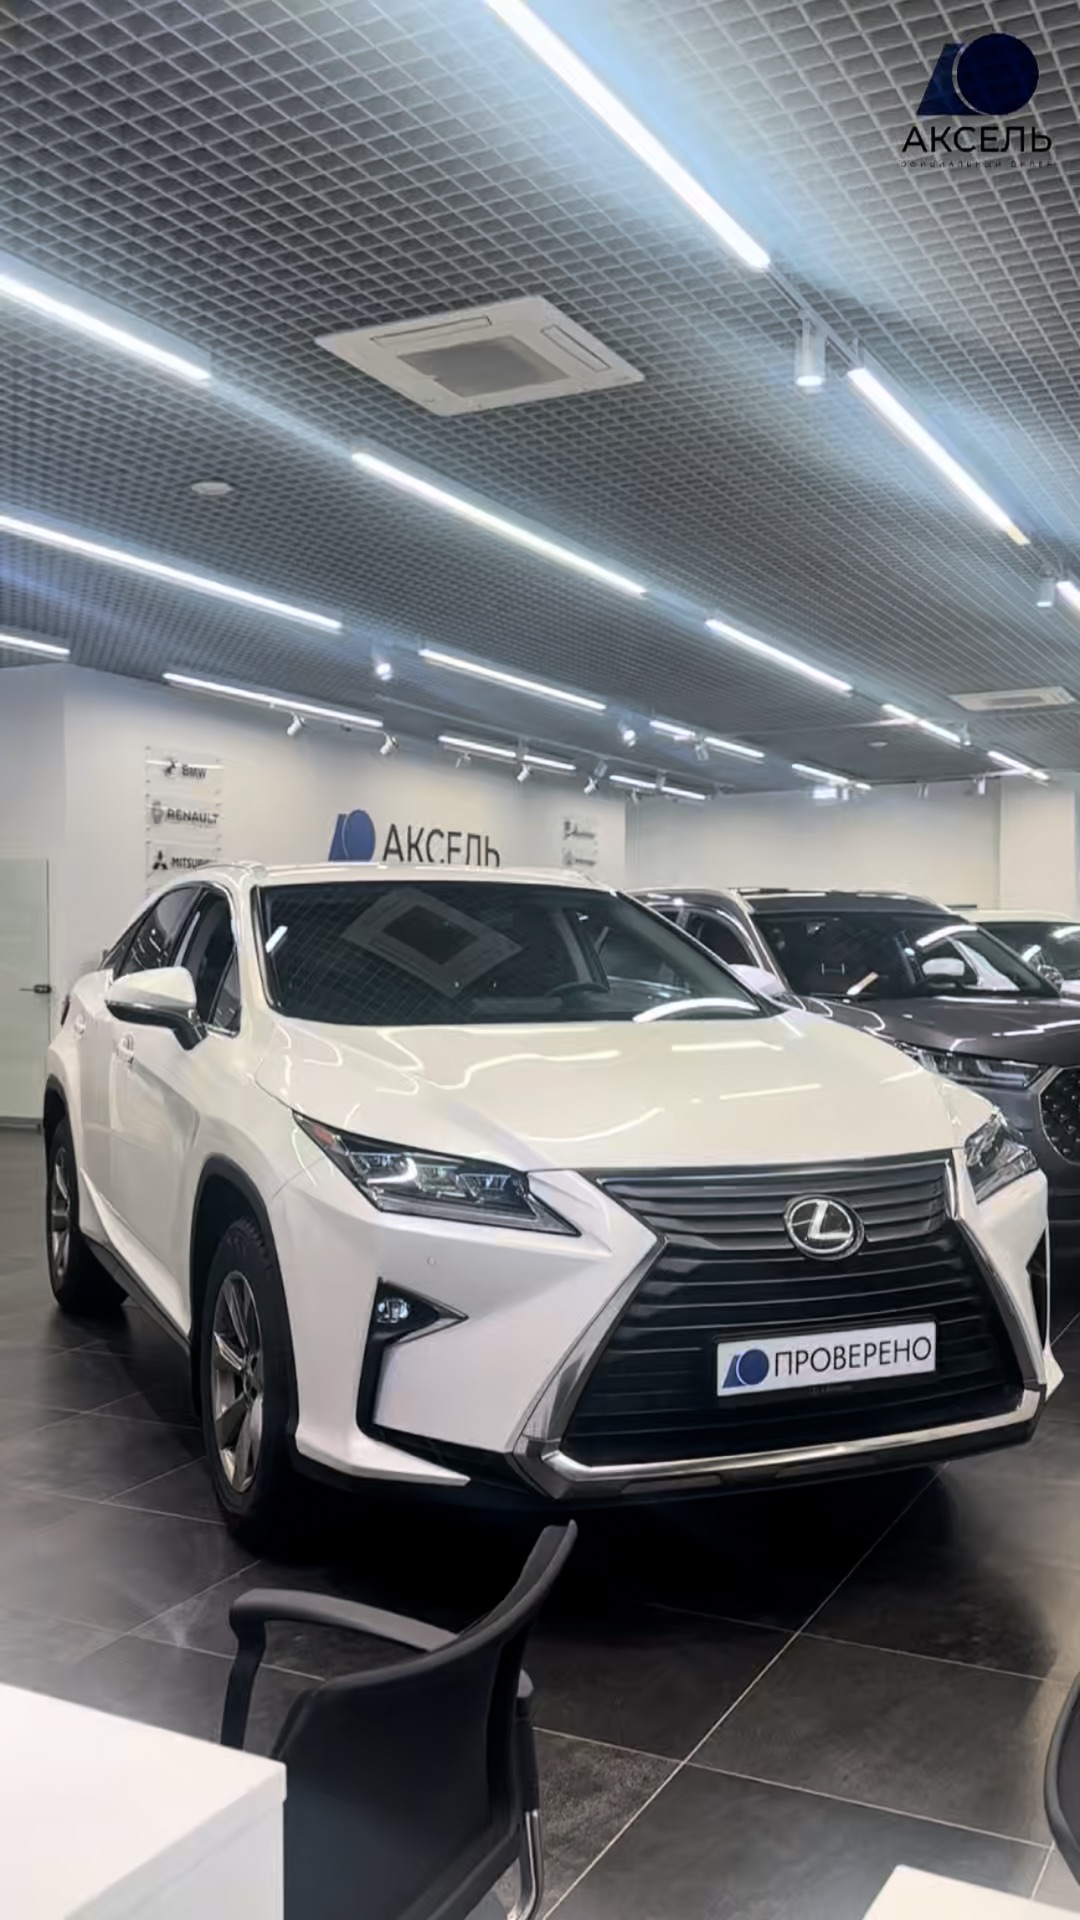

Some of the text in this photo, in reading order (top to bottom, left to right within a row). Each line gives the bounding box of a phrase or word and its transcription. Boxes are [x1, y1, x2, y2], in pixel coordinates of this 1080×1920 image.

[181, 764, 207, 779] BMW
[167, 808, 219, 824] RENAULT
[382, 823, 501, 867] АКСЕЛЬ
[774, 1336, 932, 1377] ПРОВЕРЕНО
